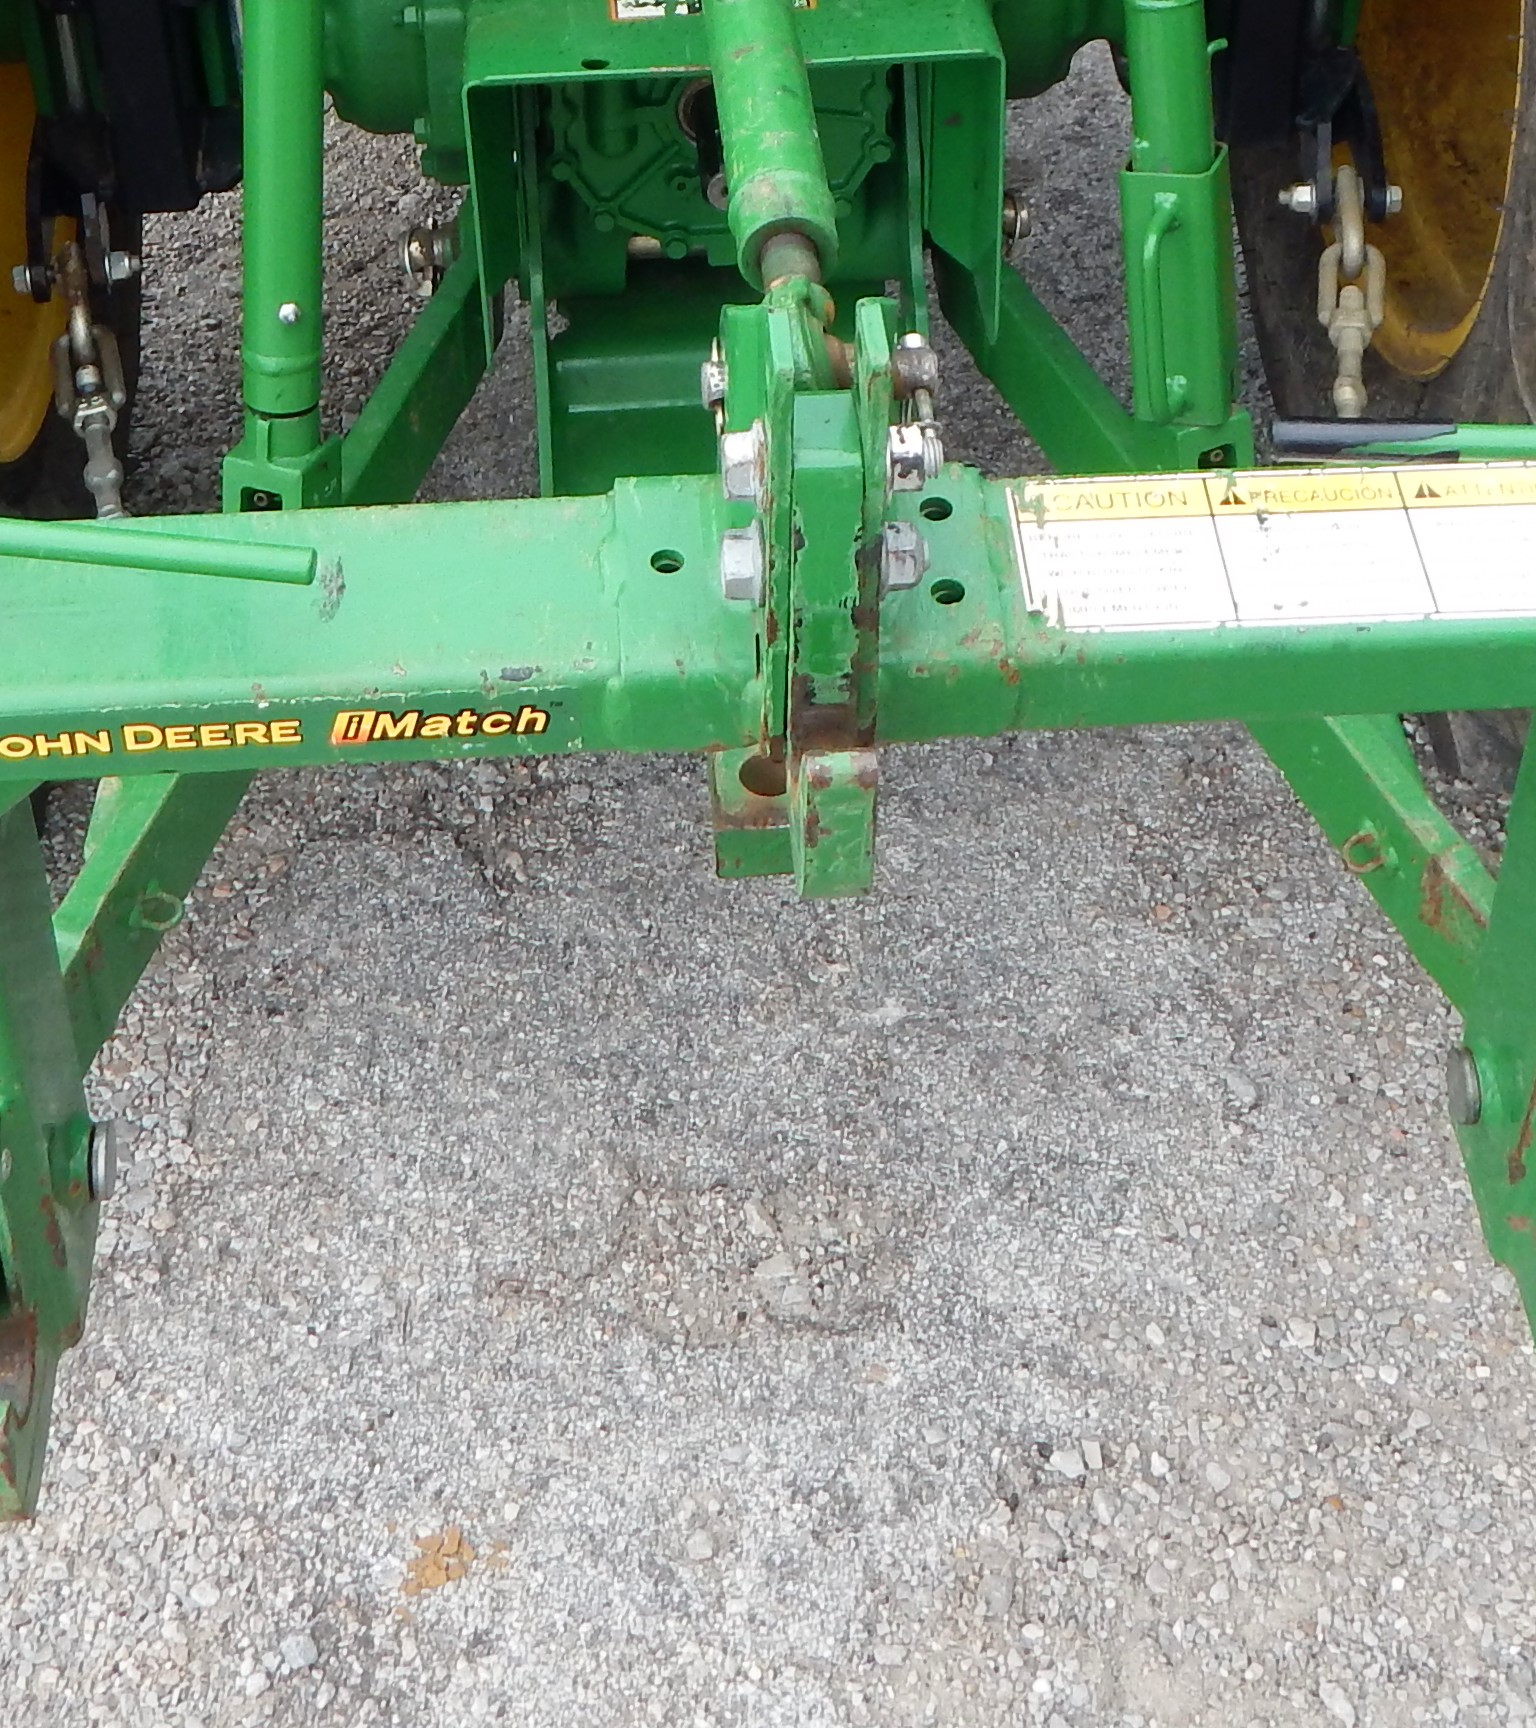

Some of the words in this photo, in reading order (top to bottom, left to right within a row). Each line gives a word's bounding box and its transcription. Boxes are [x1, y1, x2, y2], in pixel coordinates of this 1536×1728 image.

[1052, 489, 1188, 512] CAUTION
[122, 720, 304, 754] DEERE
[331, 705, 551, 746] iMatch
